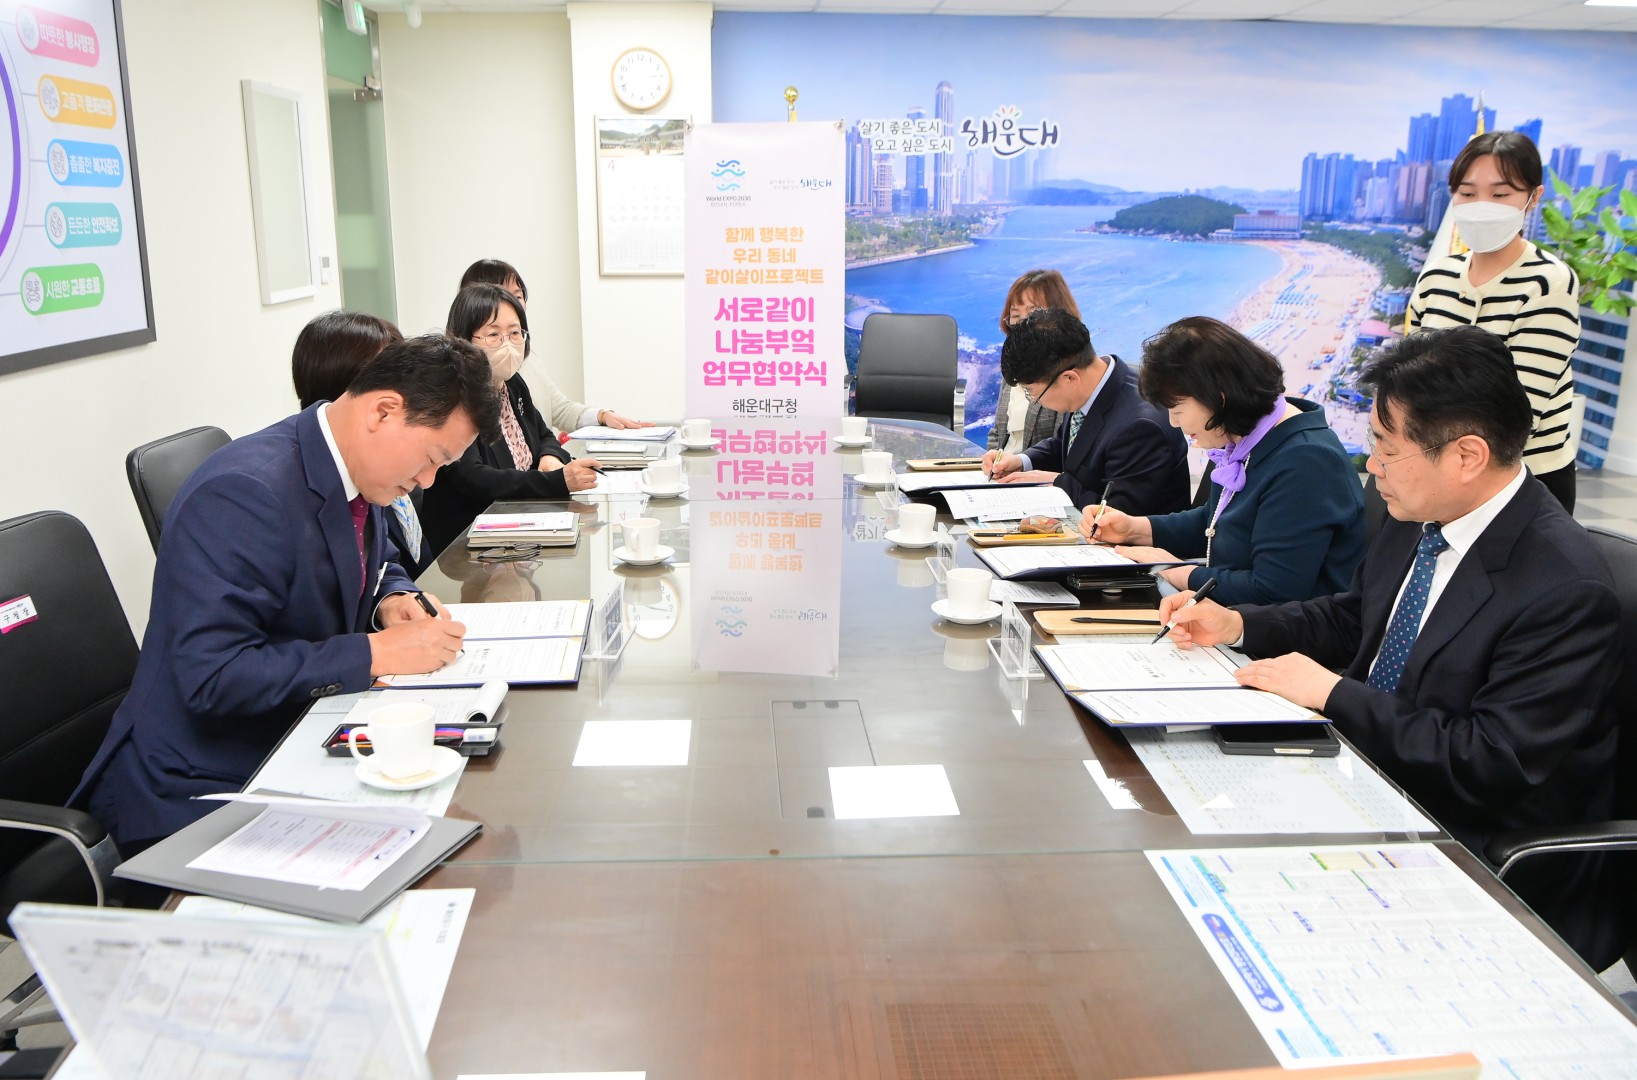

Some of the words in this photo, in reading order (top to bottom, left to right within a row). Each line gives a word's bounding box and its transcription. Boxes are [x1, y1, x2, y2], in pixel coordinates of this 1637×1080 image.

[861, 121, 885, 134] 살기
[889, 121, 913, 135] 좋은
[917, 121, 940, 134] 도시
[961, 118, 1058, 155] 해운대
[874, 140, 897, 151] 오고
[902, 139, 924, 152] 싶은
[929, 138, 952, 151] 도시
[68, 217, 90, 234] 든든한
[725, 227, 754, 243] 함께
[760, 227, 804, 243] 행복한
[733, 248, 761, 264] 우리
[767, 248, 796, 264] 동네
[705, 268, 824, 285] 같이살이프로젝트
[46, 280, 70, 299] 시원한
[714, 297, 814, 322] 서로같이
[716, 329, 814, 354] 나눔부엌
[703, 360, 827, 386] 업무협약식
[732, 398, 797, 414] 해운대구청
